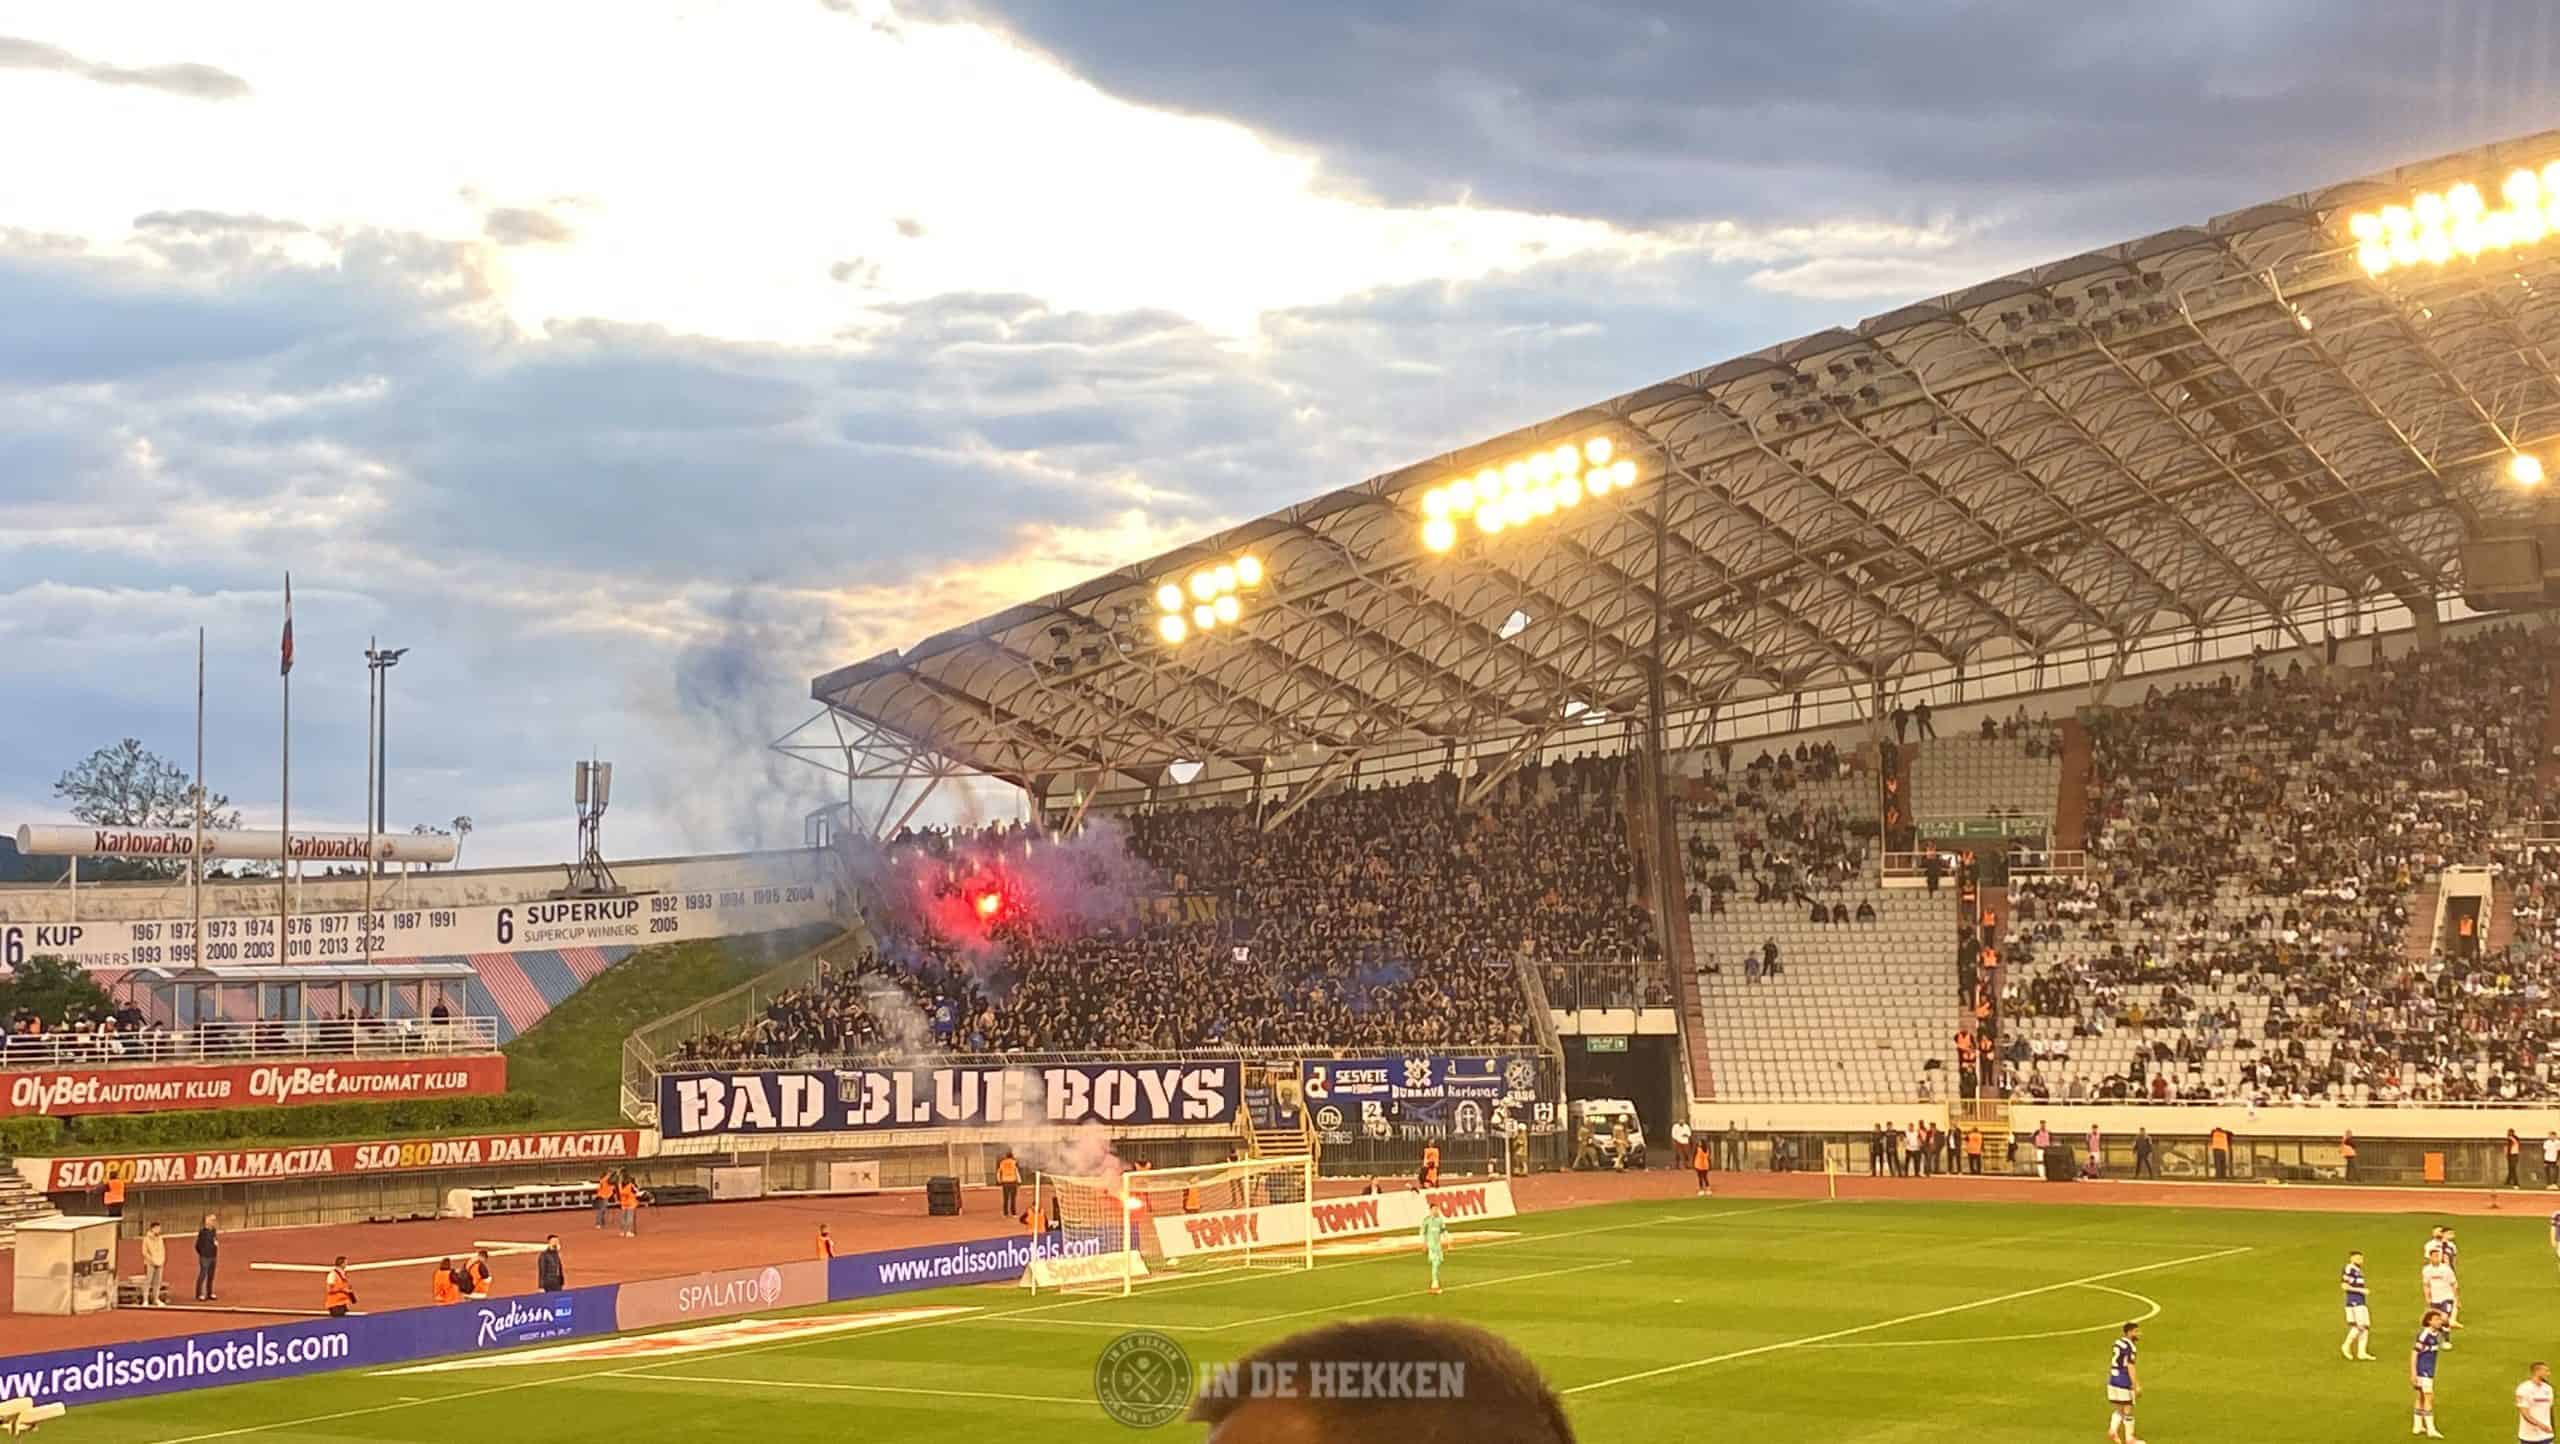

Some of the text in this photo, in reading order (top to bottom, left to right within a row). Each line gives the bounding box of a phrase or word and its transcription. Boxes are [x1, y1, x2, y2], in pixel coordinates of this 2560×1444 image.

[95, 831, 193, 855] Karlovačko
[527, 900, 639, 925] SUPERKUP
[650, 896, 678, 912] 1992
[685, 894, 712, 910] 1993
[36, 926, 83, 947] KUP
[132, 924, 161, 941] 1967
[207, 920, 237, 938] 1973
[245, 919, 274, 937] 1974
[288, 917, 312, 934] 976
[320, 915, 348, 933] 1977
[393, 912, 422, 929] 1987
[429, 911, 456, 928] 1991
[497, 908, 513, 944] 6
[524, 924, 639, 943] SUPERCUP WINNERS
[650, 916, 678, 933] 2005
[132, 946, 161, 963] 1993
[206, 943, 237, 960] 2000
[244, 941, 274, 959] 2003
[319, 937, 348, 954] 2013
[249, 1067, 468, 1104] OlyBet AUTOMAT KLUB
[1335, 1069, 1388, 1084] SESVETE
[11, 1076, 232, 1114] OlyBet AUTOMAT KLUB
[677, 1073, 824, 1133] BAD
[847, 1069, 1026, 1126] BLUE
[1044, 1068, 1225, 1121] BOYS
[194, 1148, 334, 1180] DALMACIJA
[354, 1133, 627, 1169] SLO80DNA DALMACIJA
[1311, 1199, 1380, 1234] TOMMY
[878, 1236, 1100, 1284] www.radissonhotels.com
[680, 1279, 758, 1311] SPALATO
[478, 1300, 554, 1347] Radisson
